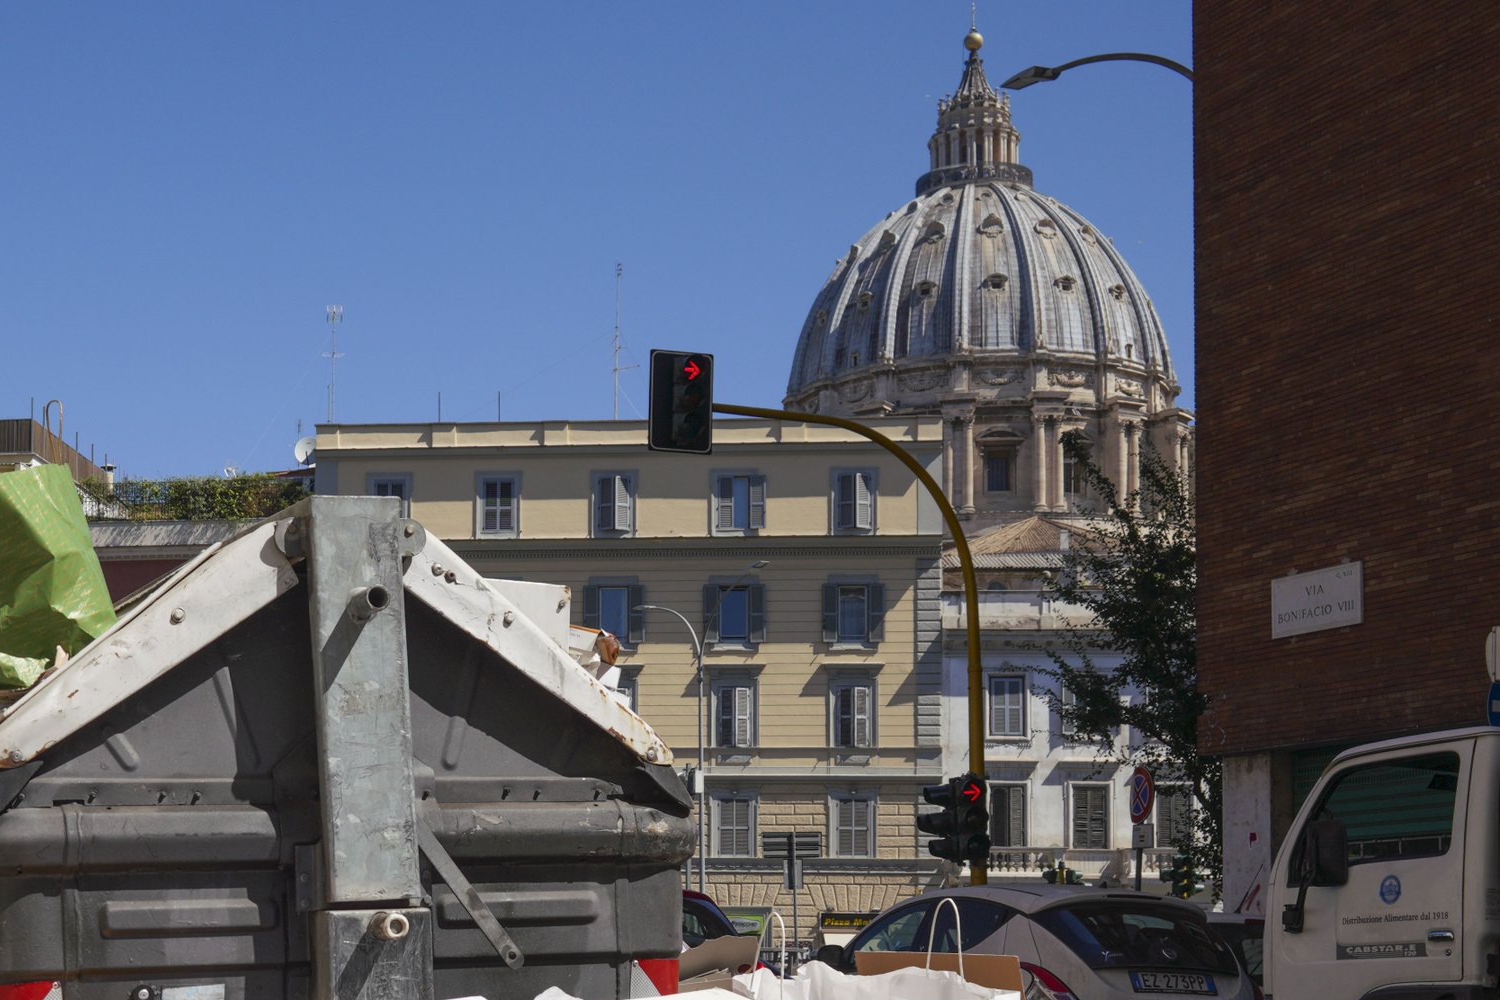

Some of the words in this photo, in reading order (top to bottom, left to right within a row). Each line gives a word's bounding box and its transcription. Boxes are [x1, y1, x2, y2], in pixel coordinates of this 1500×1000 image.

[1305, 584, 1325, 596] VIA
[1277, 604, 1333, 624] BONIFACIO
[1337, 599, 1355, 612] VIII
[824, 918, 850, 926] Pizza
[1342, 915, 1382, 926] Distribuzione
[1384, 912, 1419, 923] Alimentare
[1420, 911, 1431, 921] dal
[1432, 911, 1449, 920] 1918
[1140, 973, 1161, 989] EZ
[1162, 974, 1205, 991] 273PP
